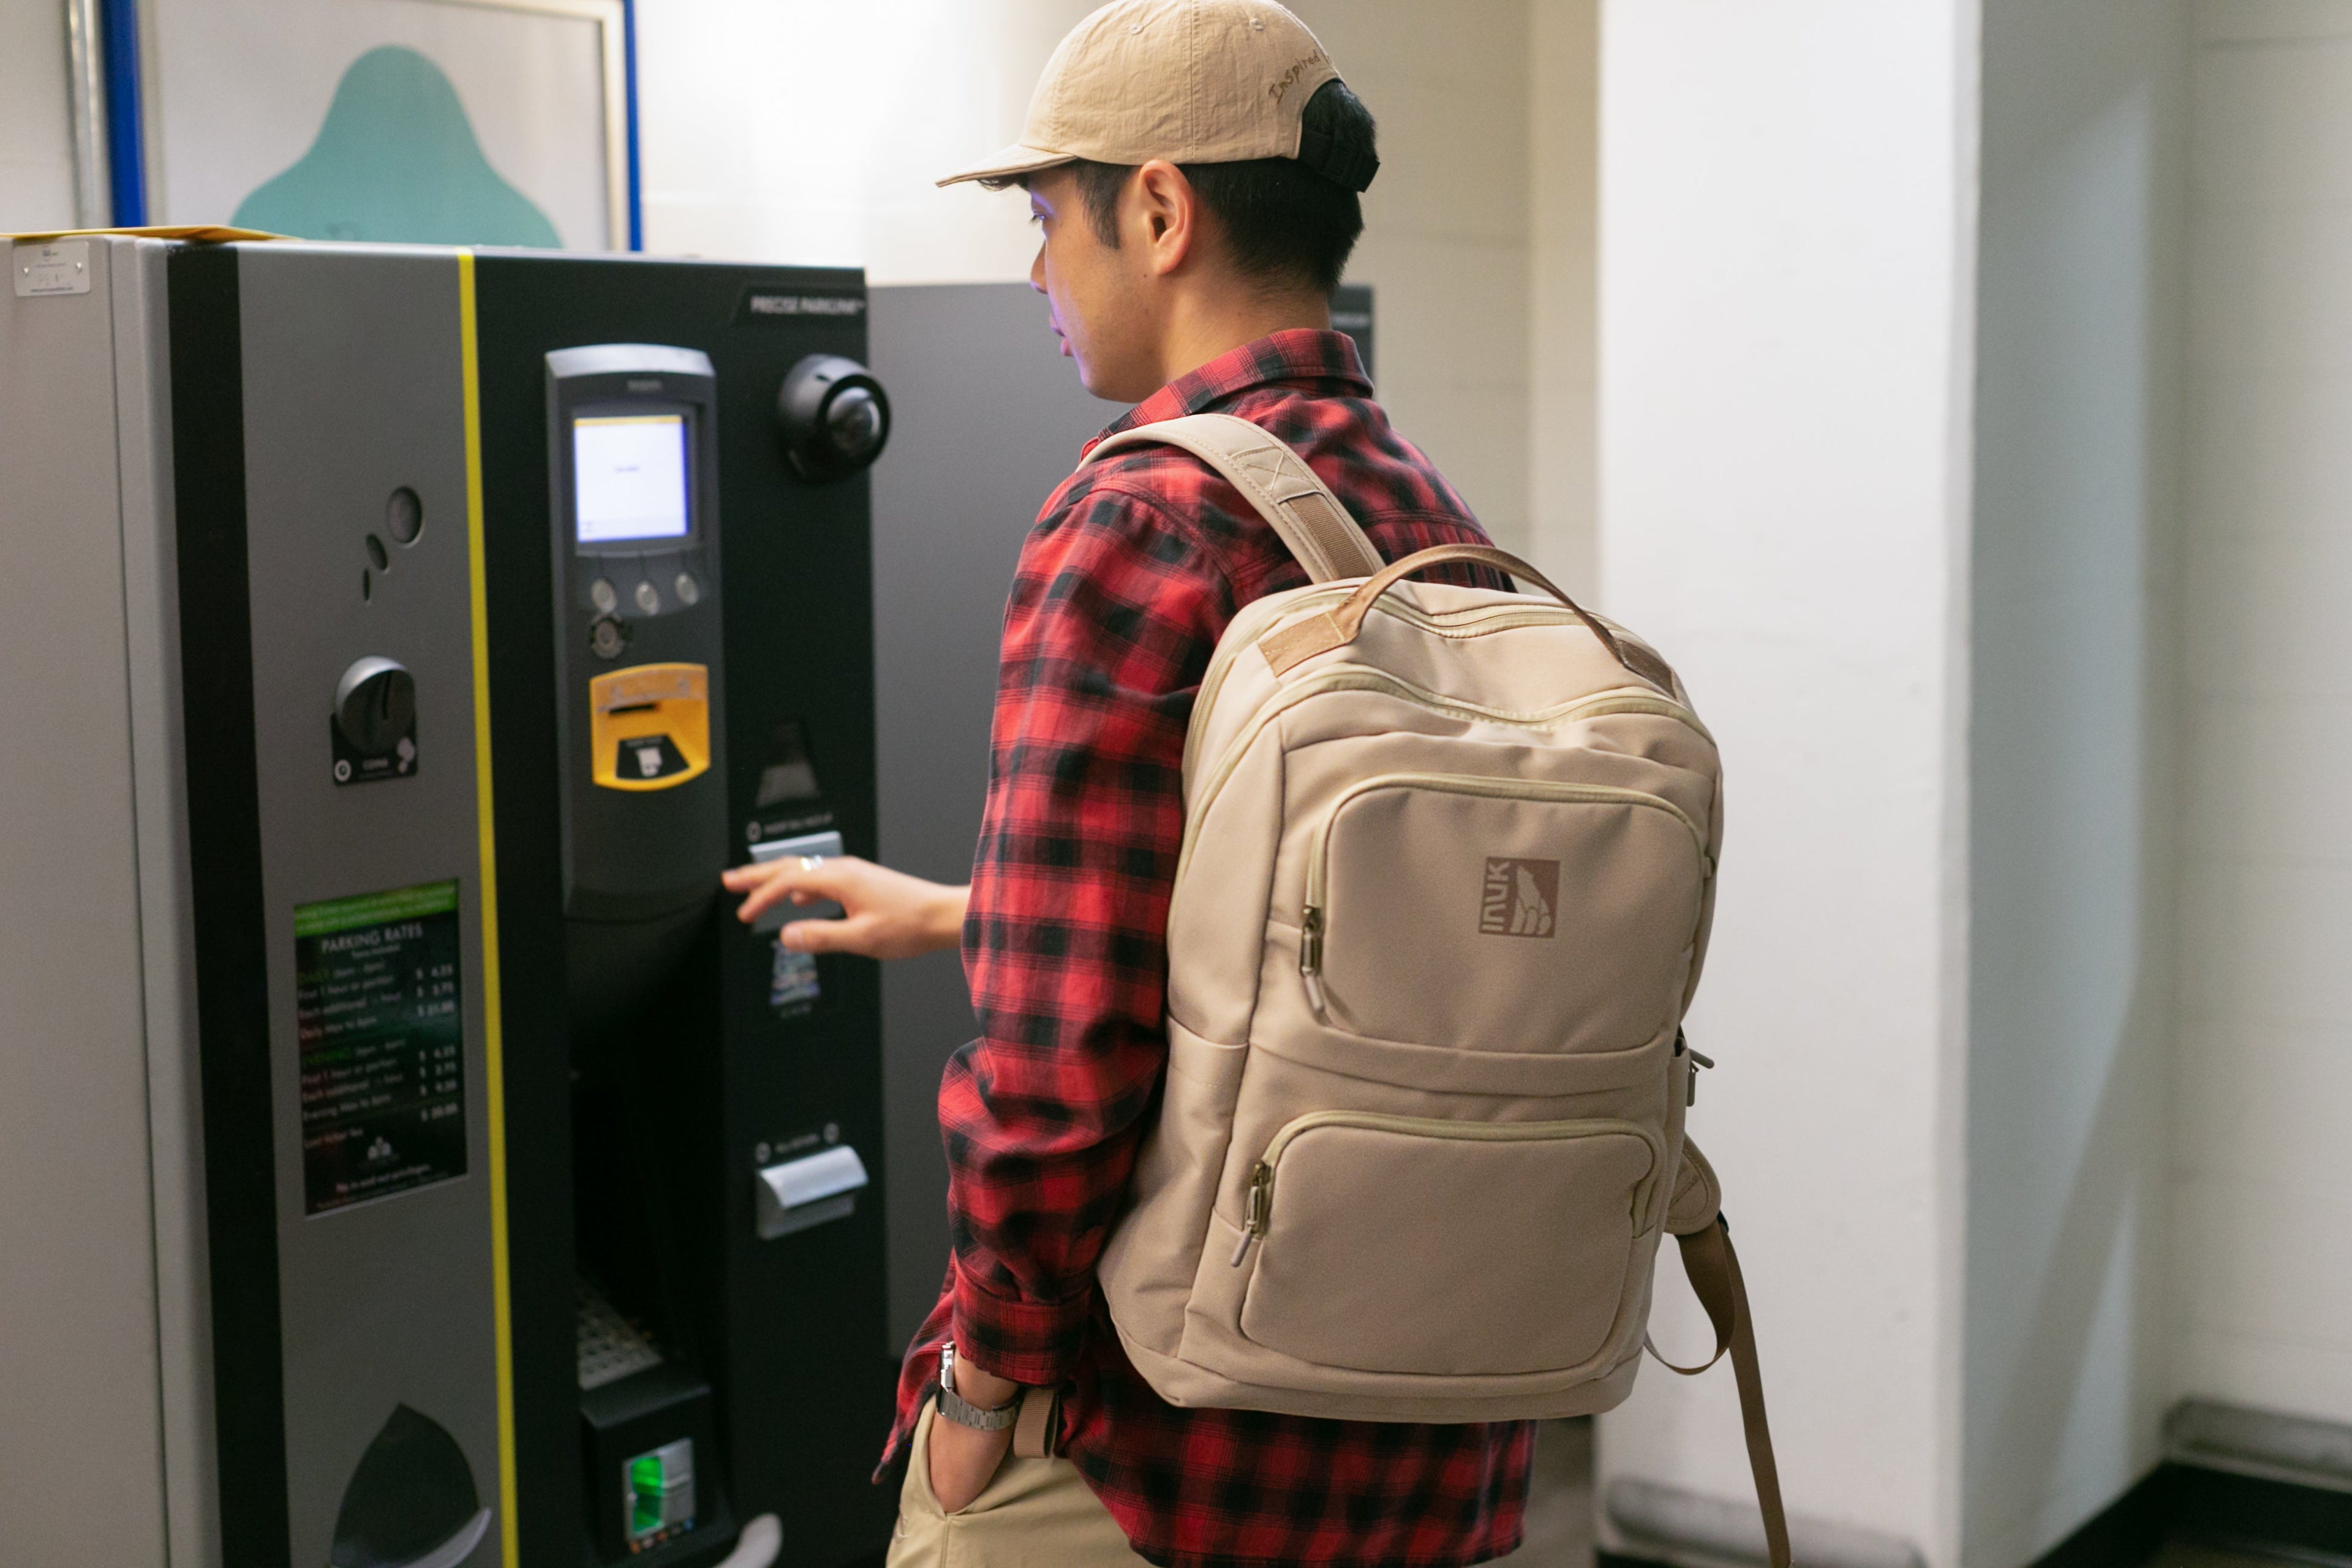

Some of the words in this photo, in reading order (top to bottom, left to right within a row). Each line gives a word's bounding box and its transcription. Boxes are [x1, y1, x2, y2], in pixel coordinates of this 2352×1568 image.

[1268, 50, 1321, 105] Inspired
[321, 930, 380, 954] PARKING
[384, 923, 423, 942] RATES
